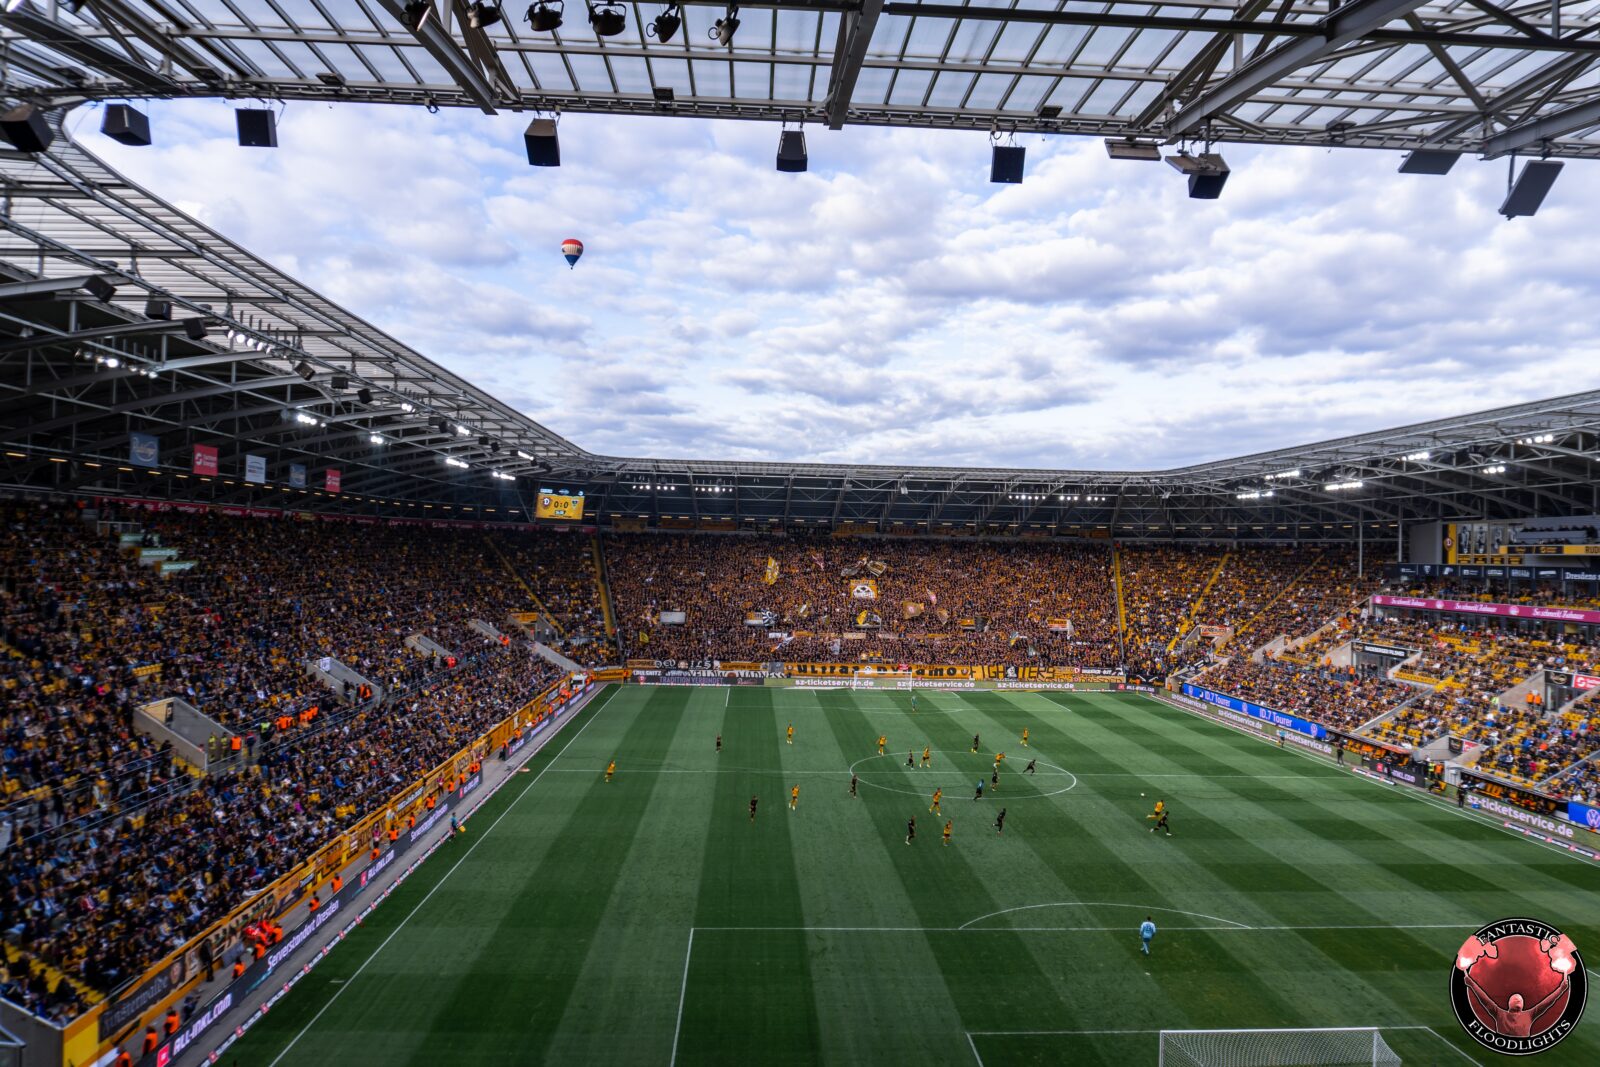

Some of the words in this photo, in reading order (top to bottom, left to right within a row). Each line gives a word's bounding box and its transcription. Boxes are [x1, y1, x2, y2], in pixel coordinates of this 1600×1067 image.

[1260, 708, 1271, 720] ID.7
[1272, 711, 1292, 727] Tourer
[1467, 794, 1574, 838] sz-ticketservice.de
[268, 920, 316, 967] Serverstandort
[316, 899, 339, 927] Dresden
